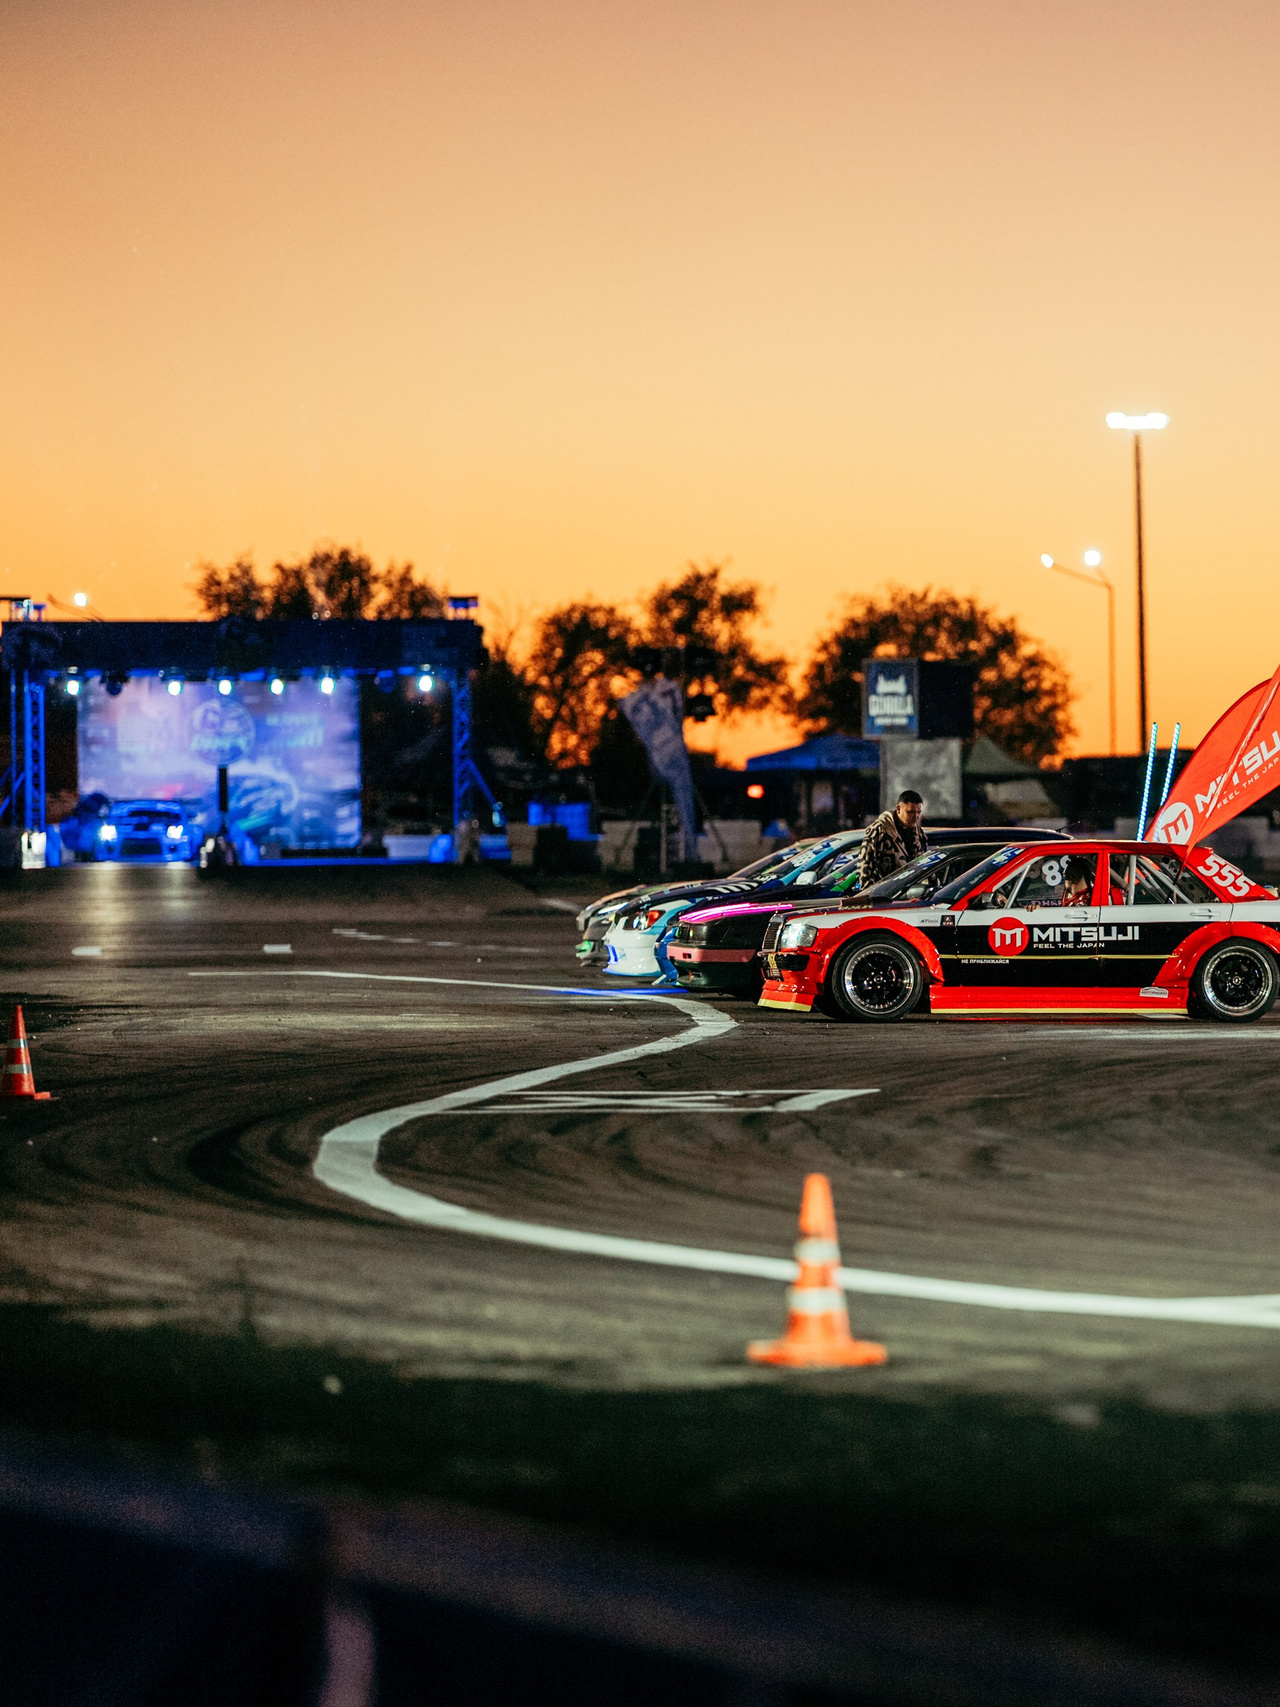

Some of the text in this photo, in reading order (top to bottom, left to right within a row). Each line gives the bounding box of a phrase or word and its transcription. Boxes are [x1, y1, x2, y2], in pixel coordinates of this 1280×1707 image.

[1217, 790, 1240, 810] FEEL
[1242, 774, 1260, 788] THE
[1197, 854, 1256, 897] 555
[1033, 926, 1139, 942] MITSUJI
